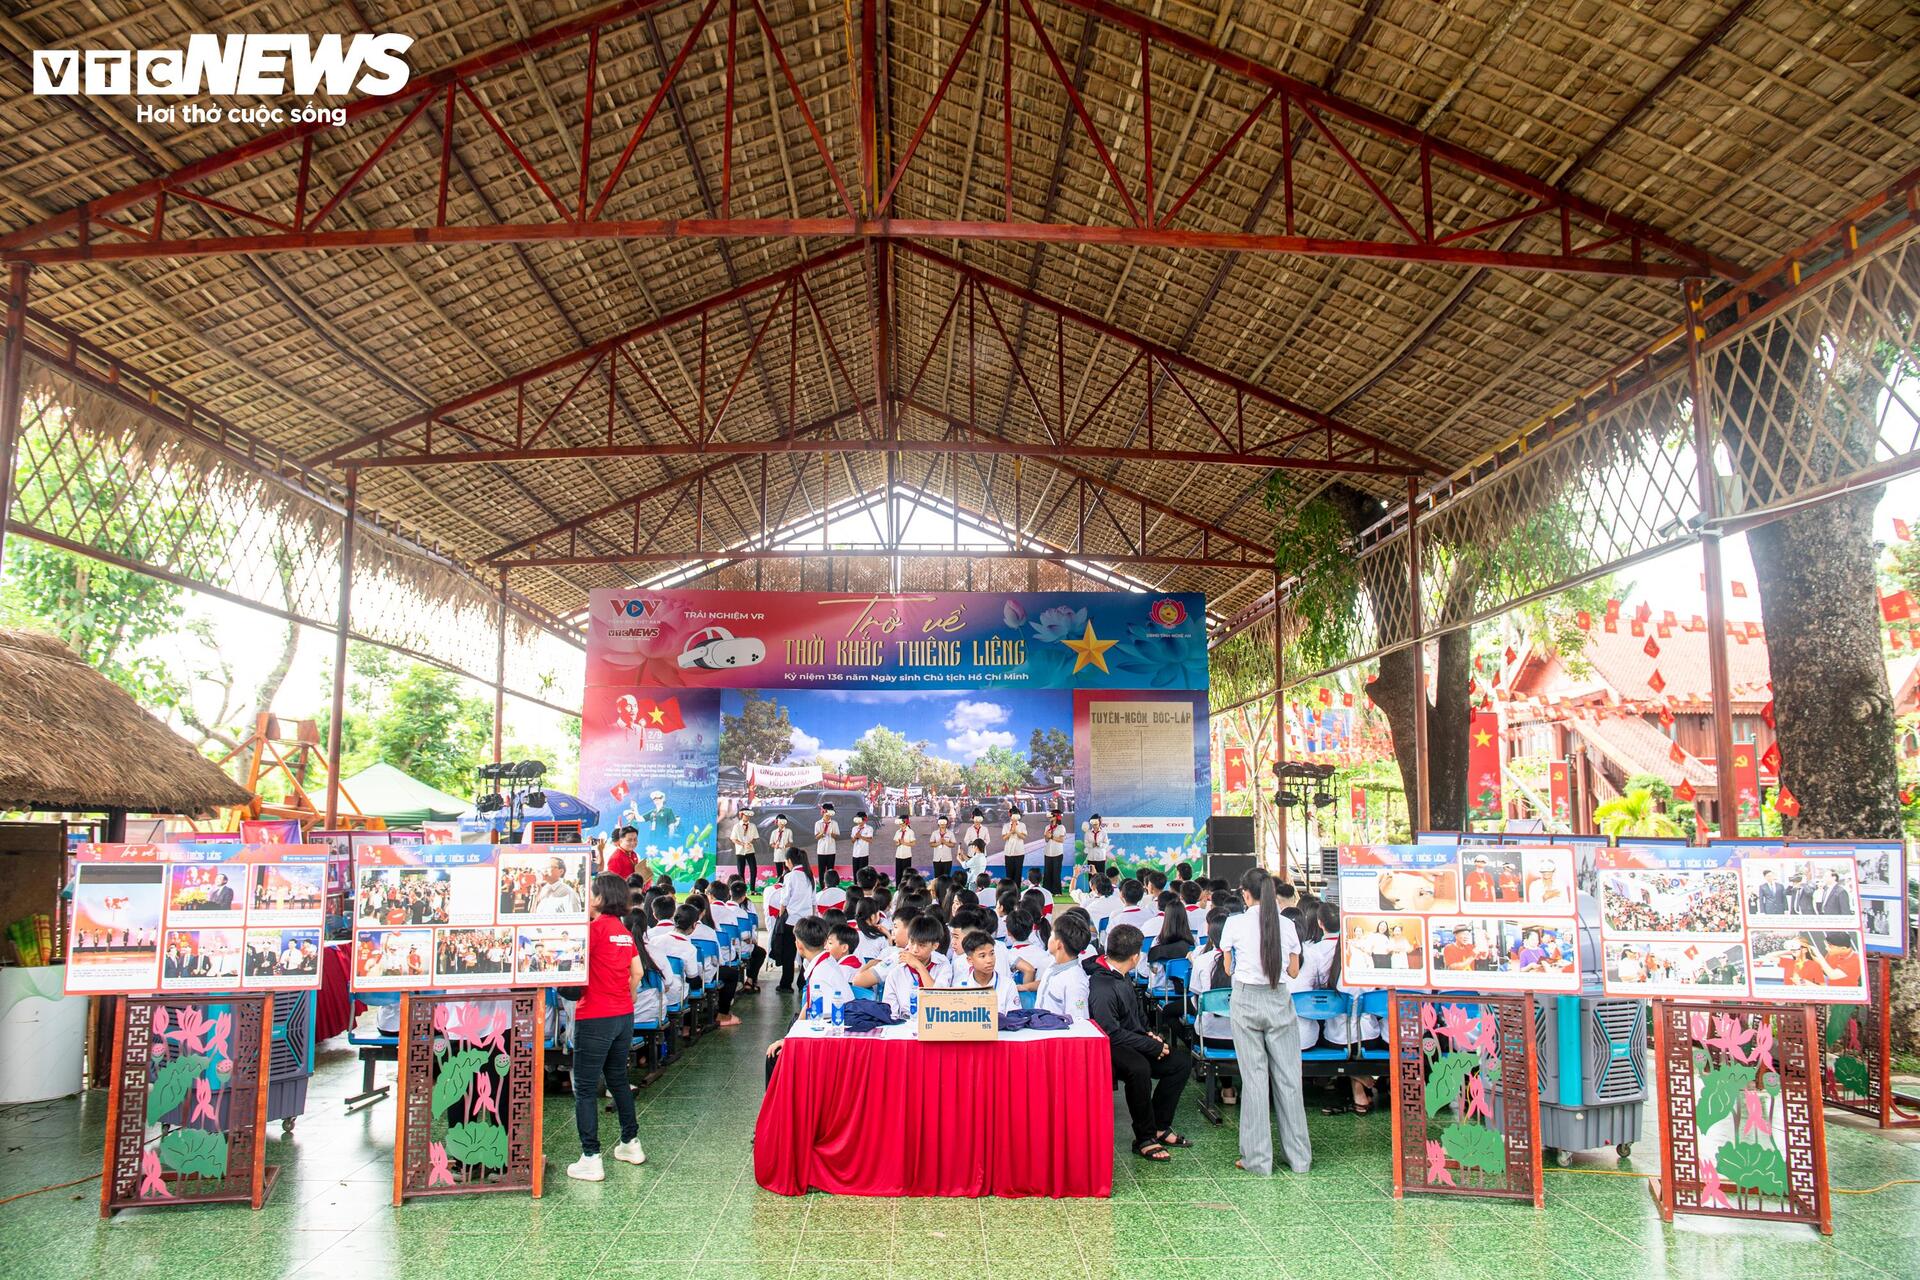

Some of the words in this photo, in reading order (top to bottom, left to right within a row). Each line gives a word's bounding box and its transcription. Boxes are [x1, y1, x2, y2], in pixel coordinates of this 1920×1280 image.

[609, 599, 662, 619] VOV
[683, 610, 707, 619] TRẢI
[708, 611, 749, 621] NGHIỆM
[922, 604, 968, 633] về
[783, 633, 825, 666] THỜI
[836, 632, 884, 667] KHẮC
[896, 636, 962, 667] THIÊNG
[973, 635, 1026, 666] LIÊNG
[800, 673, 825, 682] niệm
[827, 673, 844, 681] 136
[846, 673, 868, 681] năm
[871, 674, 898, 683] Ngày
[900, 674, 921, 682] sinh
[923, 673, 944, 681] Chủ
[946, 673, 966, 683] tịch
[984, 673, 1002, 681] Chí
[1004, 673, 1029, 681] Minh
[925, 1007, 991, 1022] Vinamilk
